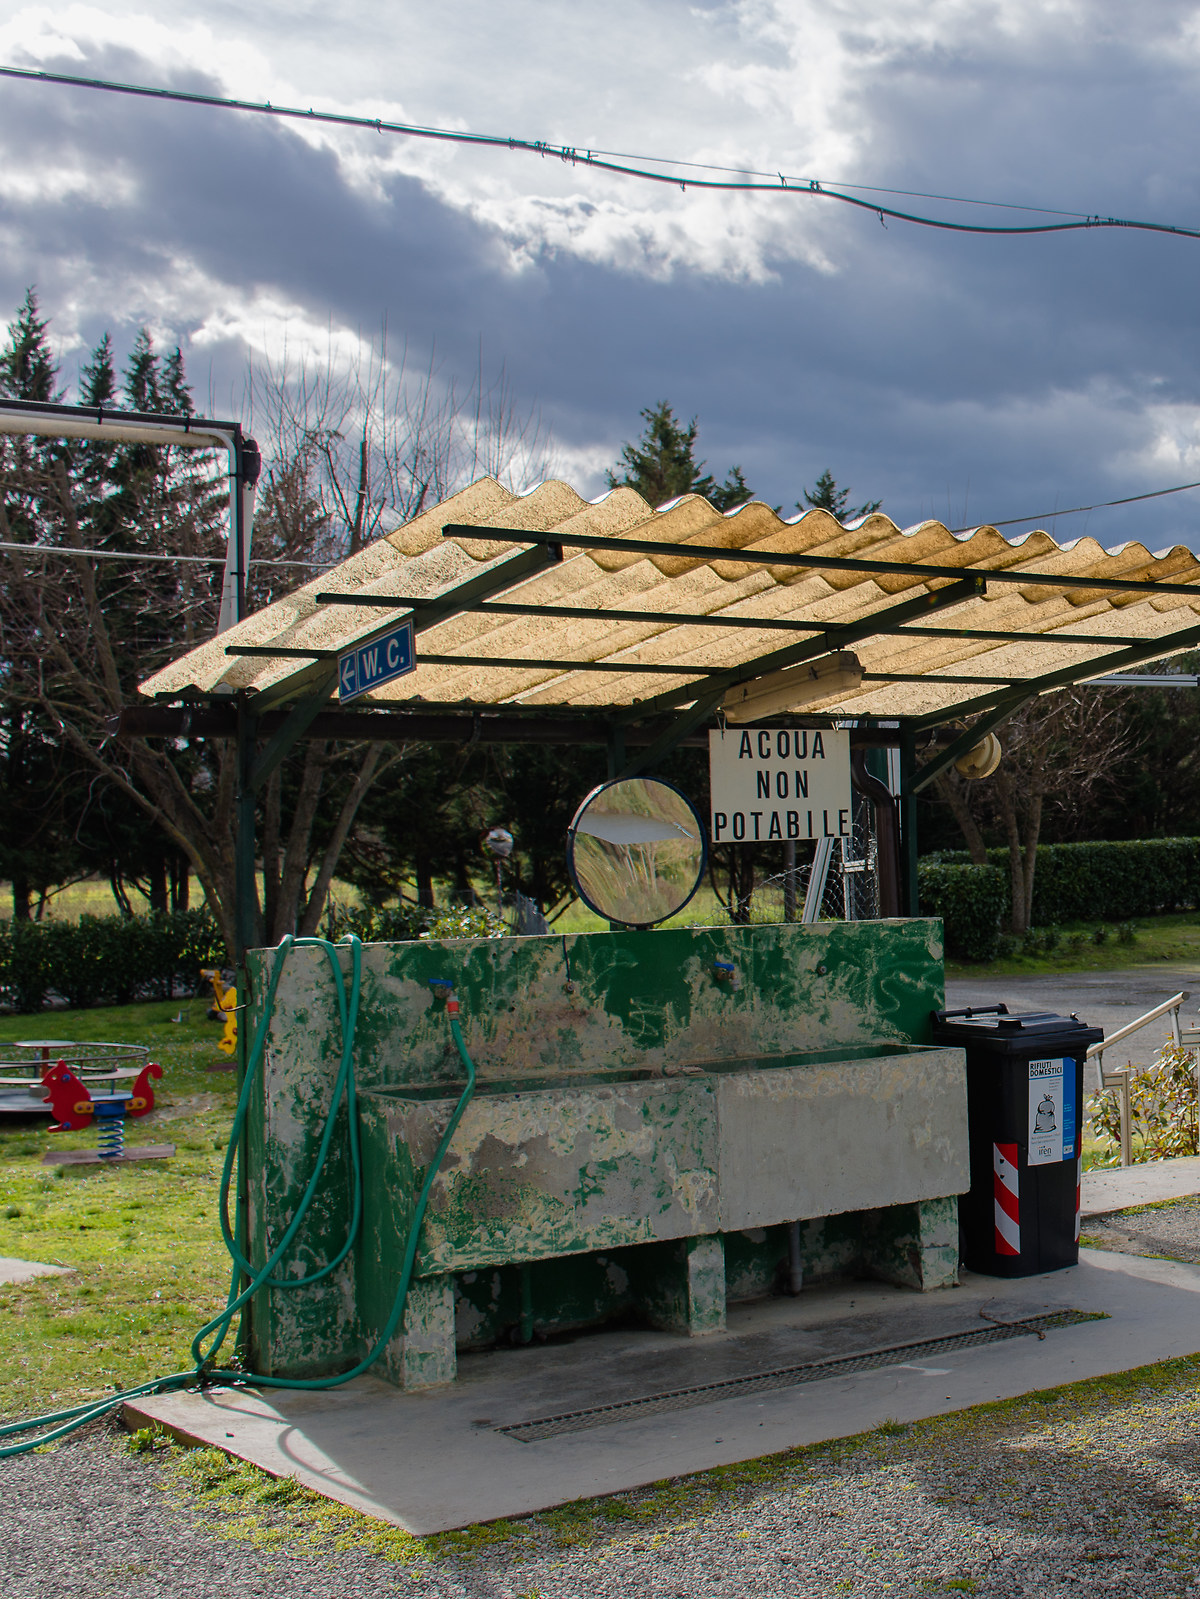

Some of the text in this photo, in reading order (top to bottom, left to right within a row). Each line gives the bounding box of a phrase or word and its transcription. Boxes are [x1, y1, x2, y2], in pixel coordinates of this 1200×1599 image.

[738, 730, 826, 760] ACQUA
[756, 770, 809, 799] NON
[714, 809, 850, 841] POTABILE
[1030, 1061, 1052, 1070] RIFIUTI
[1030, 1067, 1062, 1077] DOMESTICI
